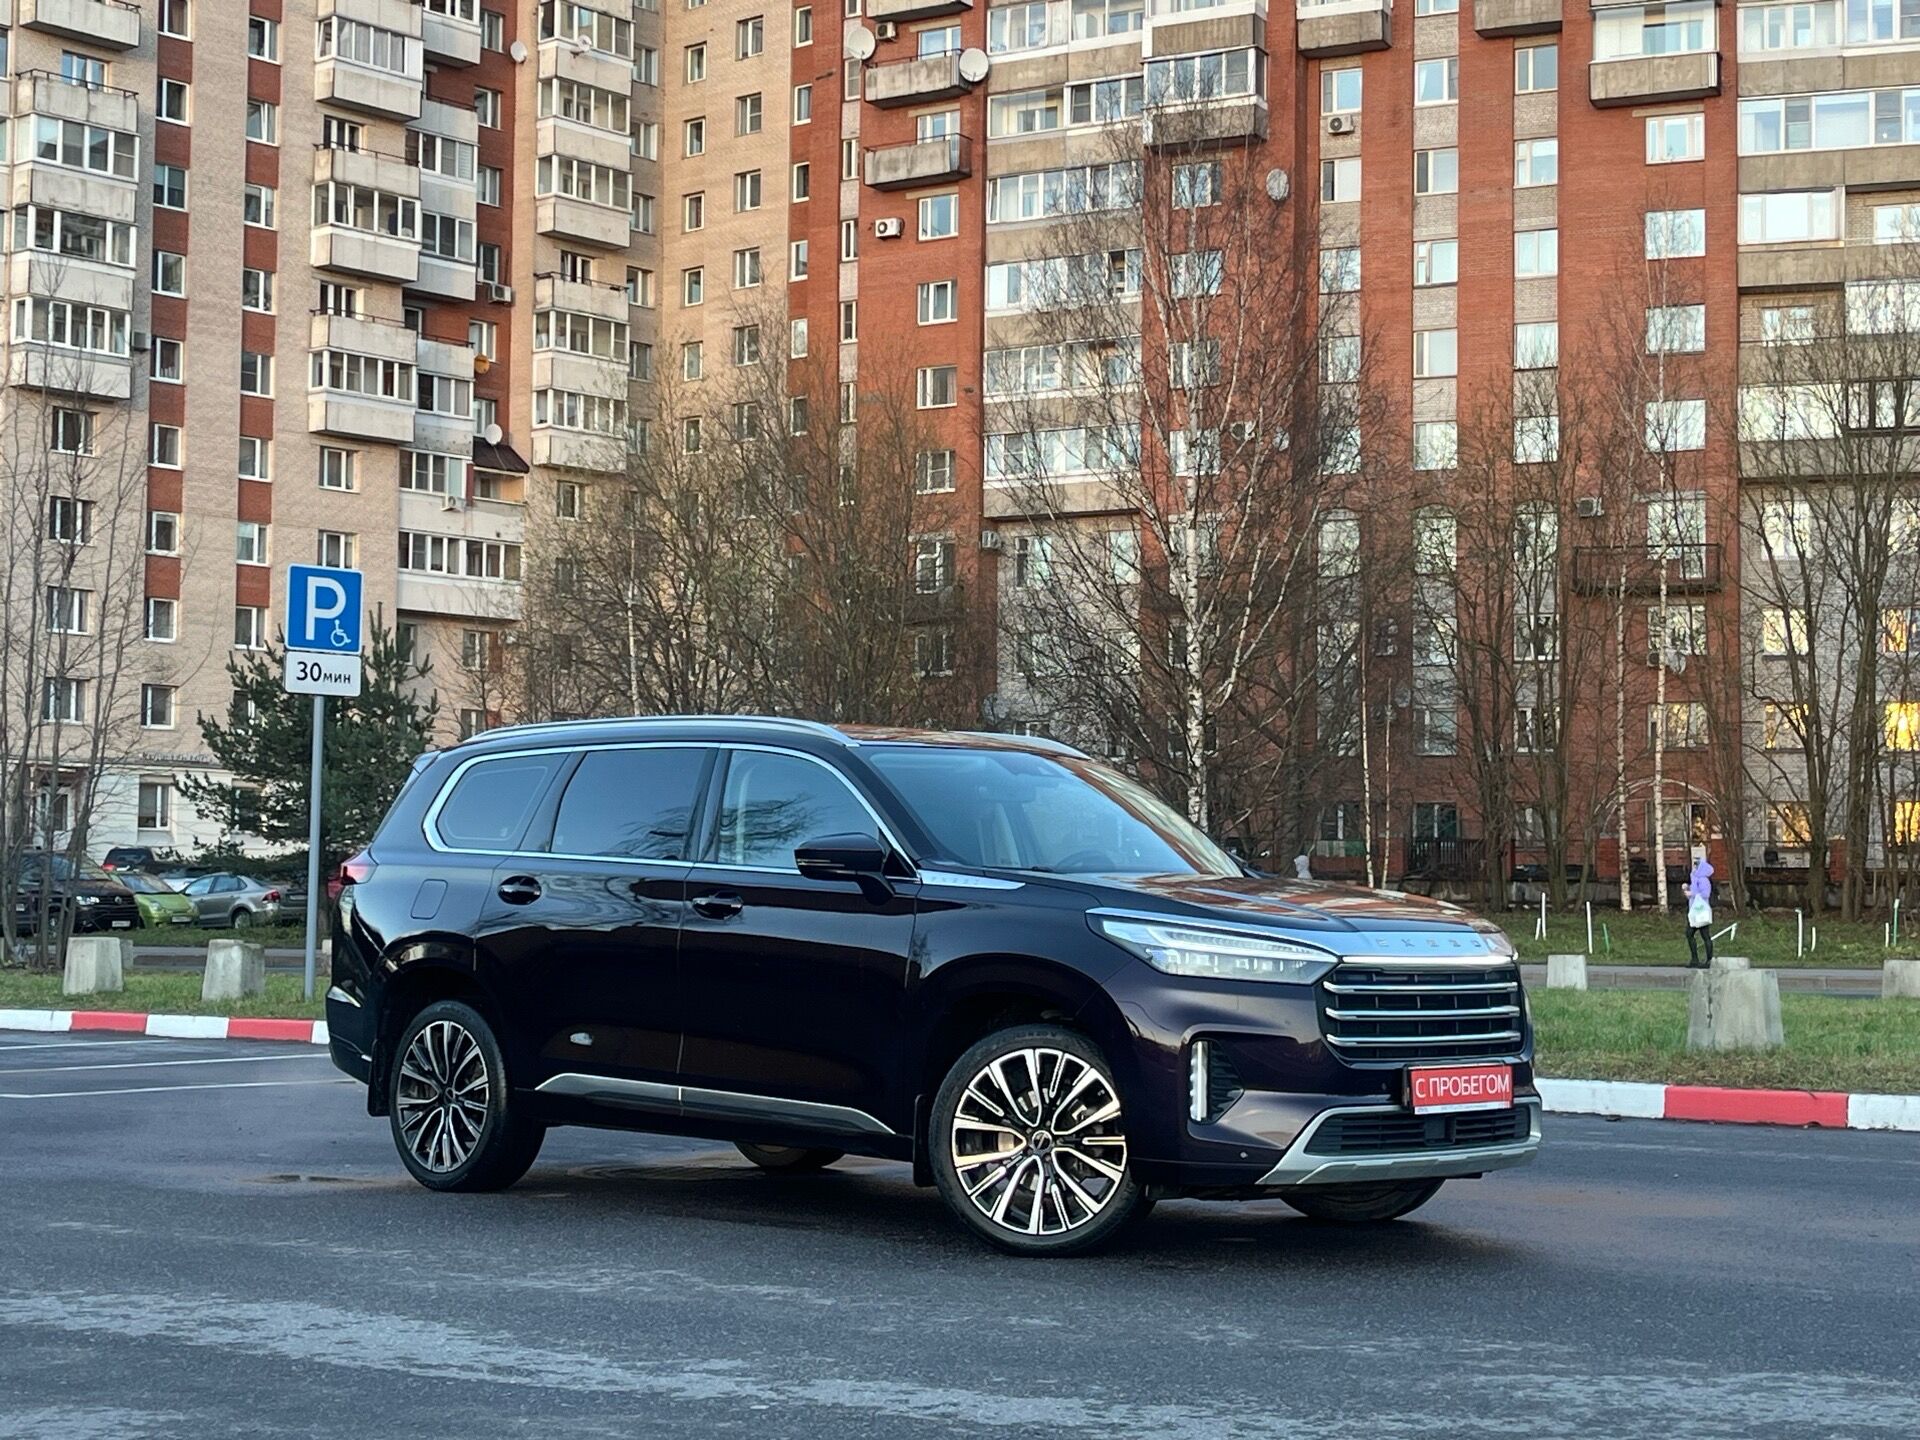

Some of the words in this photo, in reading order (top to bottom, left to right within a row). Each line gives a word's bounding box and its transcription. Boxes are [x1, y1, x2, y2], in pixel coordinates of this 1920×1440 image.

[305, 575, 347, 640] P
[1415, 1078, 1426, 1098] С
[1429, 1073, 1510, 1097] ПРОБЕГОМ
